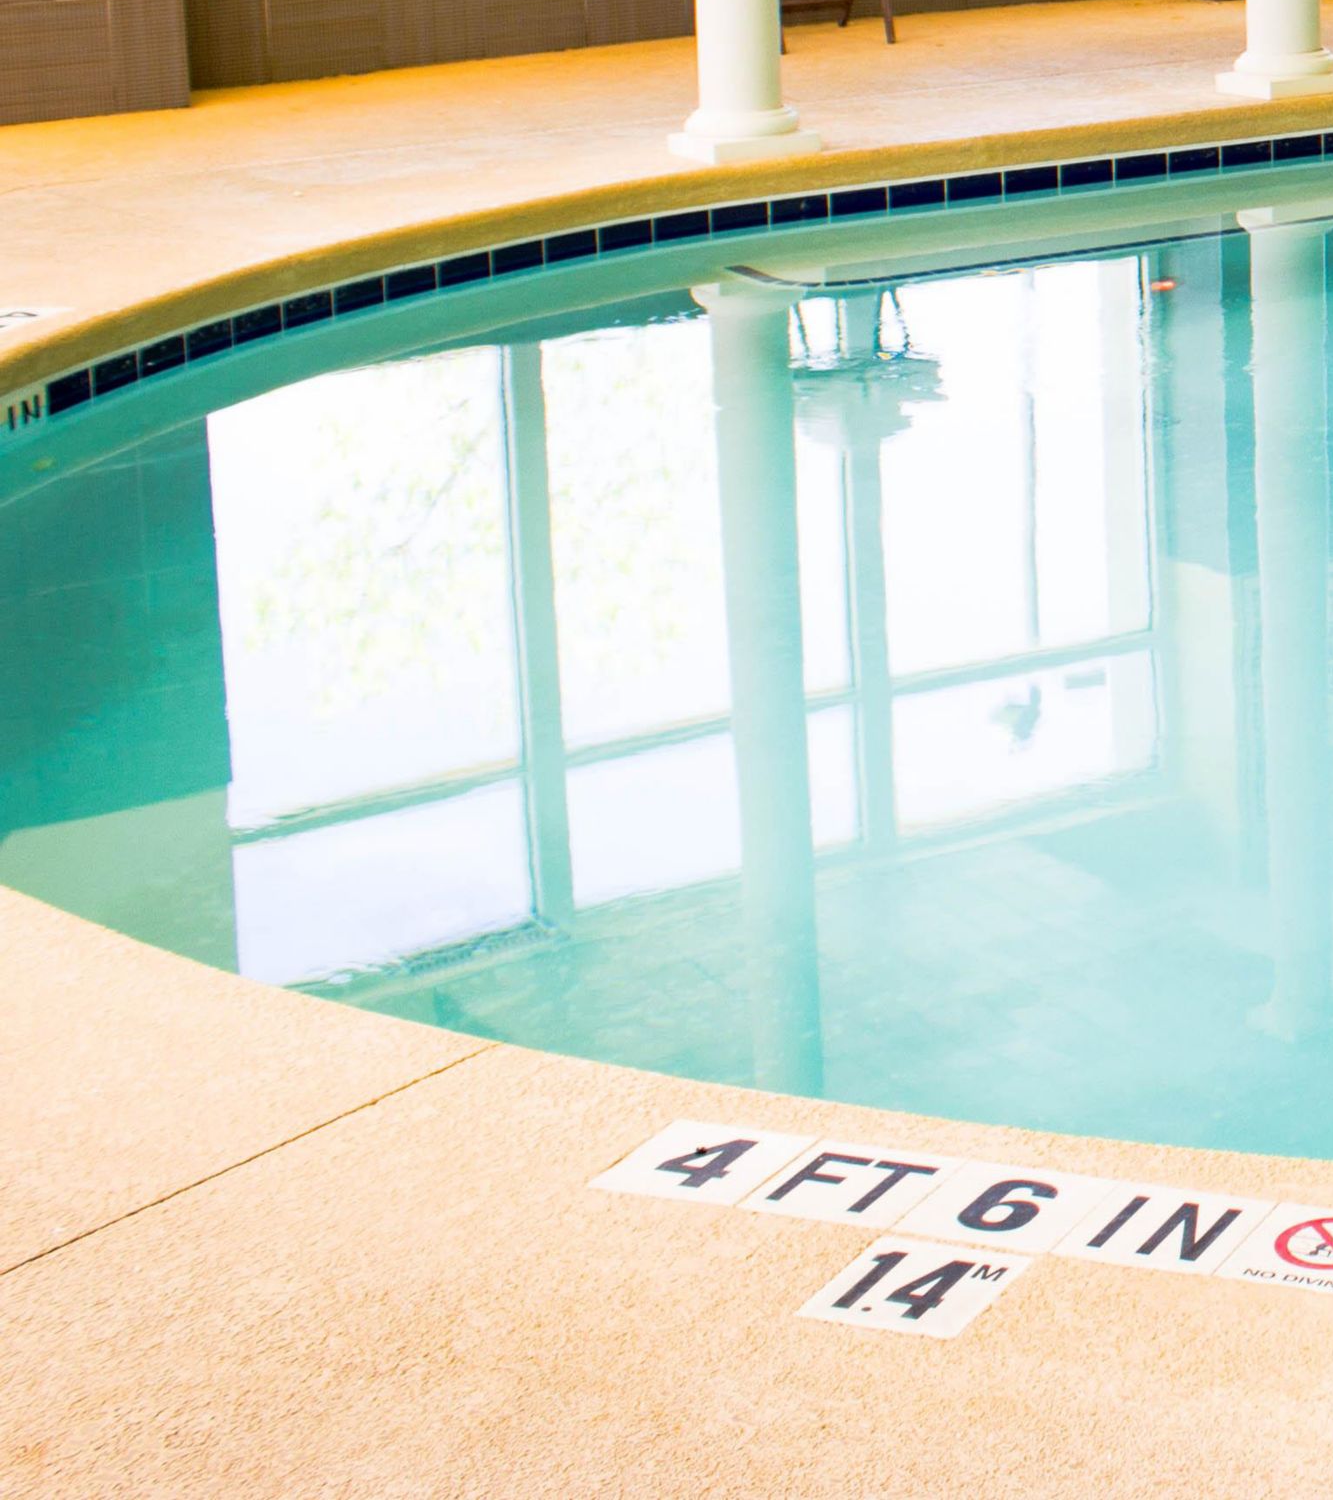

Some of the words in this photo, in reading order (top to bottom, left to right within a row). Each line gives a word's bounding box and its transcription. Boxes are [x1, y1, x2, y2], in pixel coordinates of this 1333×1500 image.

[654, 1138, 758, 1189] 4
[767, 1151, 939, 1215] FT
[956, 1178, 1059, 1234] 6
[1086, 1195, 1243, 1263] IN
[1243, 1267, 1277, 1279] NO
